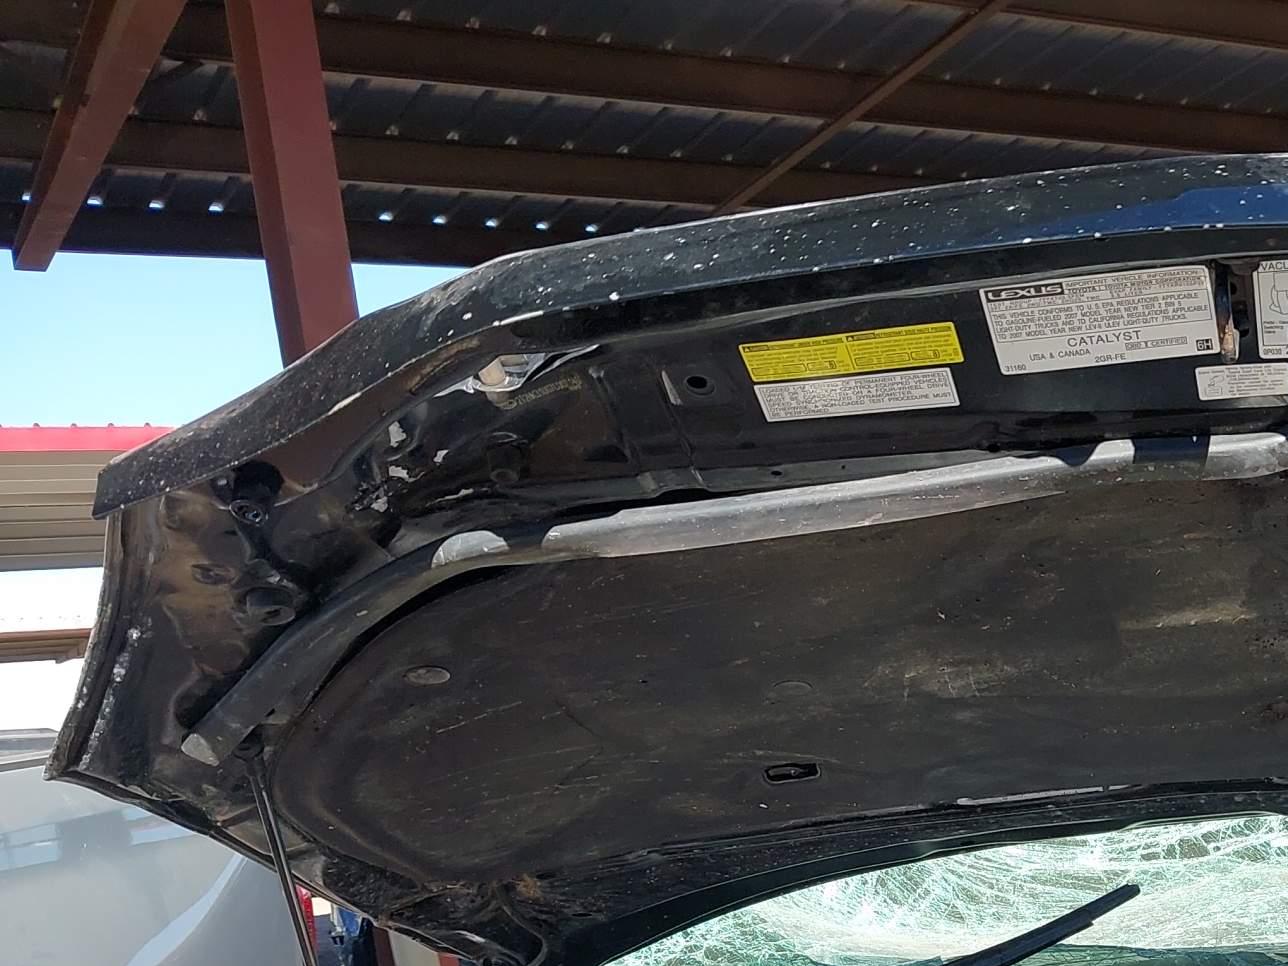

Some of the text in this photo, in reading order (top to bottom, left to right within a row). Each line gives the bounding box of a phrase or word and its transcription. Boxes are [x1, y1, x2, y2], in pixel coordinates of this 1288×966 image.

[1065, 279, 1107, 288] IMPORTANT
[987, 284, 1063, 299] LEXUS
[1117, 296, 1159, 306] REGULATIONS
[1162, 293, 1199, 301] APPLICABLE
[1081, 309, 1103, 317] MODEL
[1088, 314, 1124, 324] CALIFORNIA
[1127, 309, 1170, 319] REGULATIONS
[1172, 304, 1209, 314] APPLICABLE
[1067, 330, 1142, 347] CATALYST
[1197, 339, 1212, 351] 6H
[1029, 354, 1046, 362] USA
[1058, 348, 1091, 358] CANADA
[1094, 353, 1126, 363] 2GR-FE
